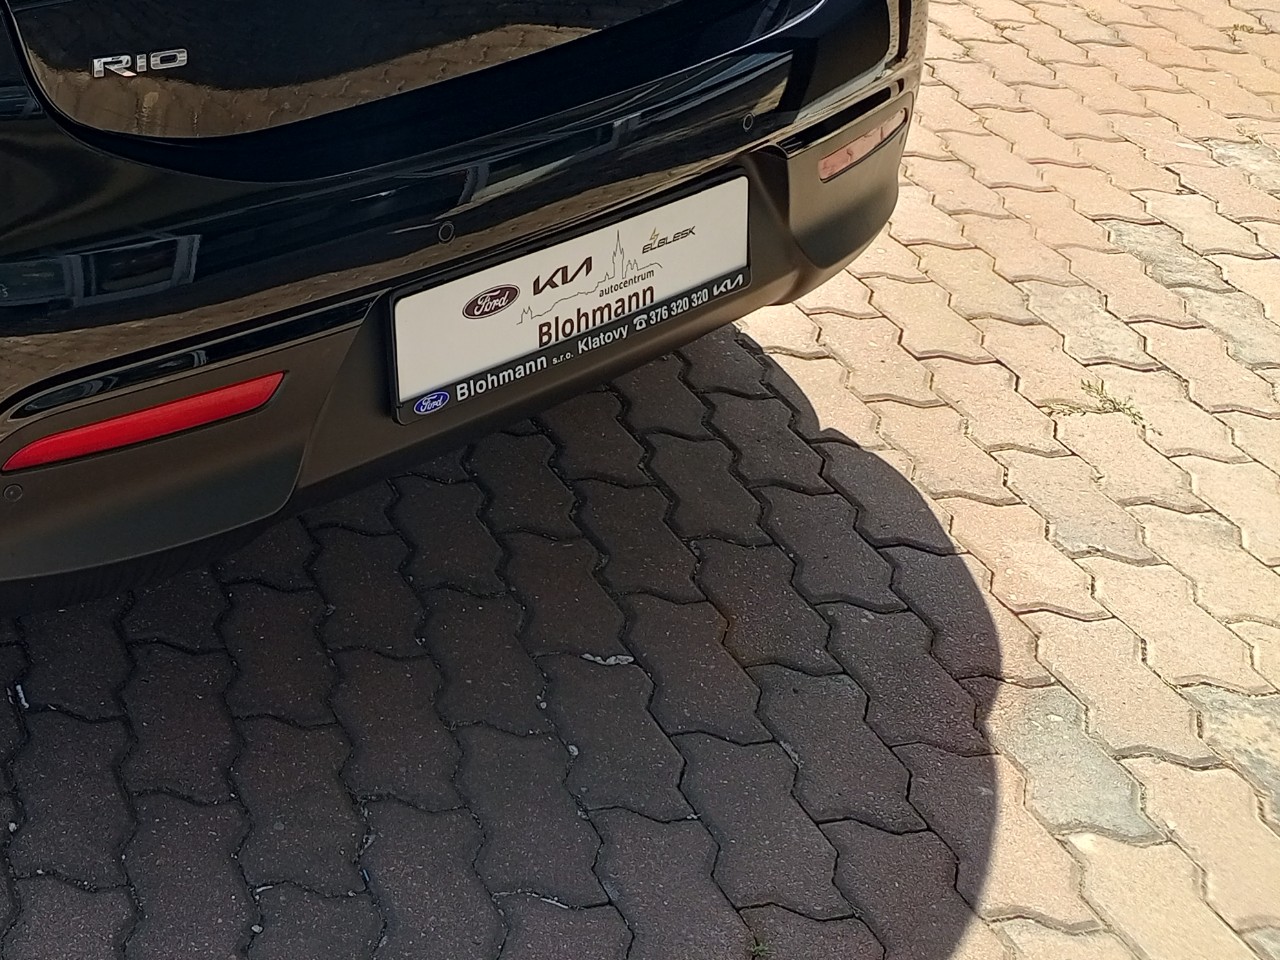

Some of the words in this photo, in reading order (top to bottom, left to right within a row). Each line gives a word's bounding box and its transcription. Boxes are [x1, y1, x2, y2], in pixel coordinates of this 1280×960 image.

[92, 48, 188, 78] RIO
[641, 226, 697, 254] ELBLESK
[532, 255, 593, 296] KIA
[599, 269, 655, 298] autocentrum
[538, 286, 655, 349] Blohmann
[456, 356, 548, 402] Blohmann
[552, 351, 575, 365] s.r.o.
[577, 324, 630, 355] Klatovy
[649, 305, 669, 325] 376
[670, 298, 690, 317] 320
[691, 289, 709, 308] 320
[712, 273, 744, 297] KIA
